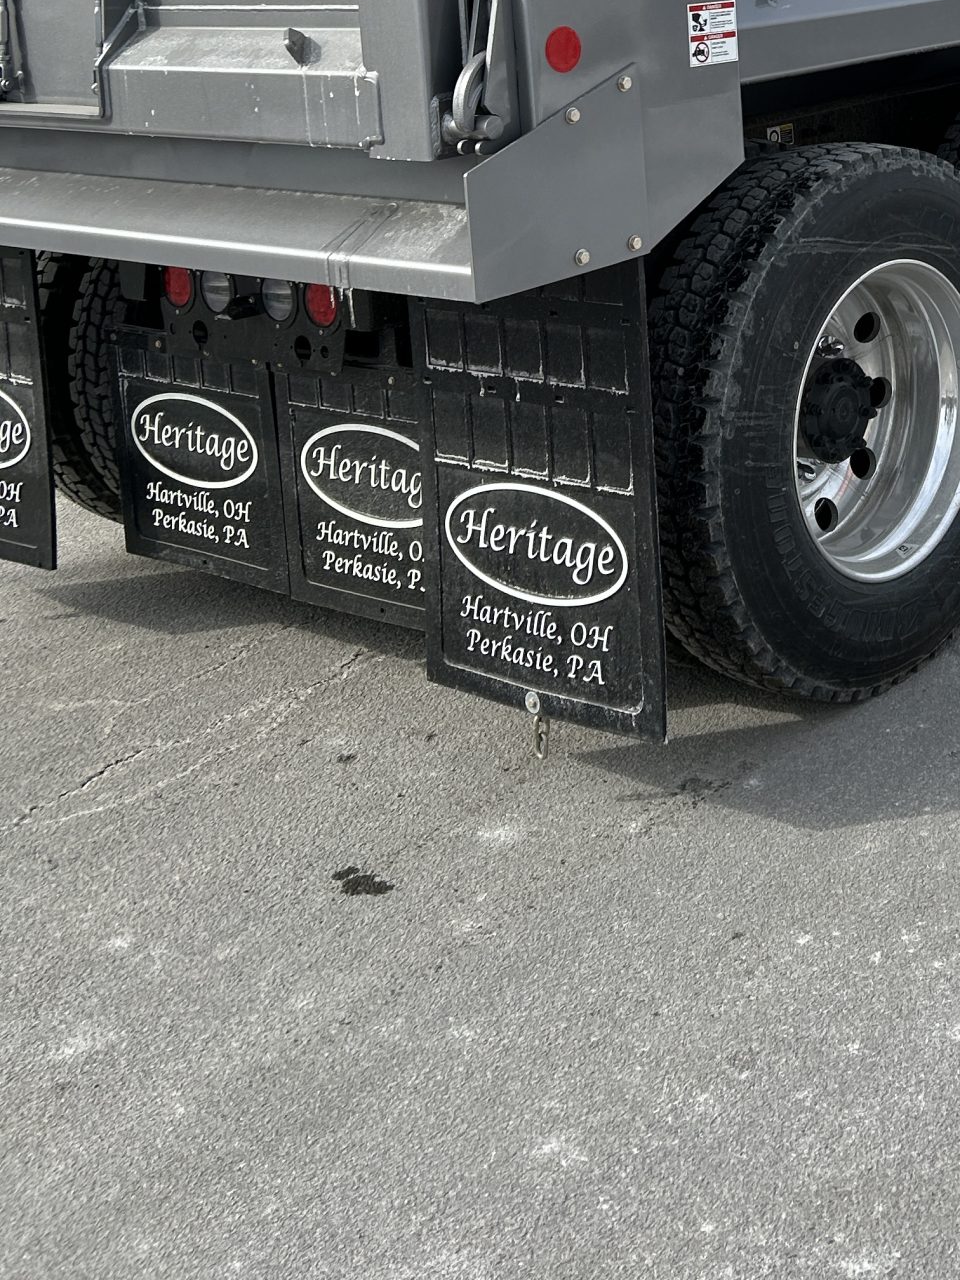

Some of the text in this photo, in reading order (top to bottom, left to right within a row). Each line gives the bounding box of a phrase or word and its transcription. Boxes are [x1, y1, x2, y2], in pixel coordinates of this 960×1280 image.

[138, 411, 251, 471] Heritage
[146, 481, 252, 523] Hartville, OH
[310, 444, 423, 509] Heritag
[152, 508, 250, 549] Perkasie, PA
[316, 520, 425, 562] Hartville, O
[456, 507, 615, 586] Heritage
[322, 550, 426, 593] Perkasie, P
[460, 595, 614, 652] Hartville, OH
[466, 628, 606, 686] Perkasie, PA
